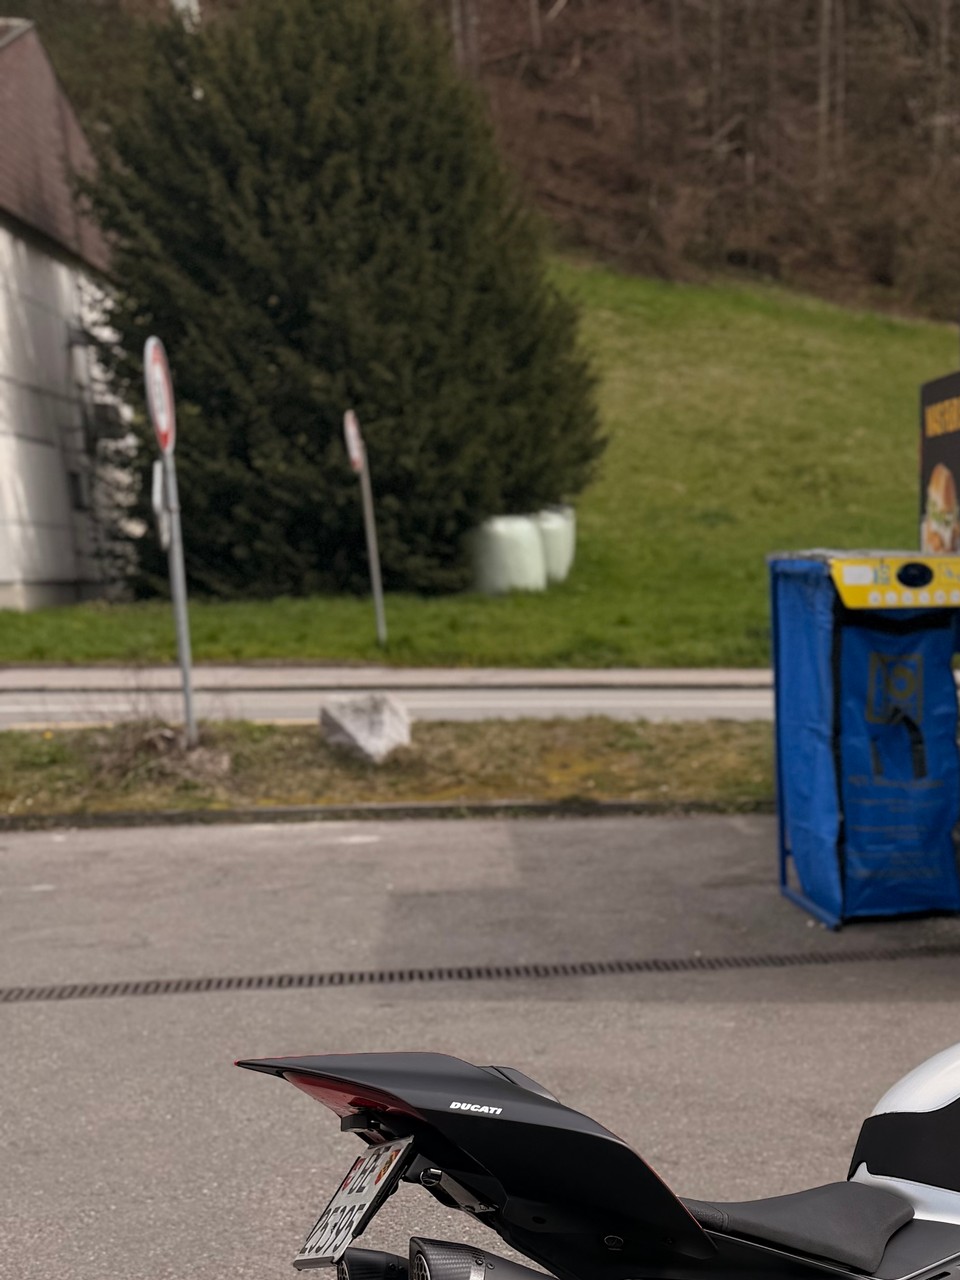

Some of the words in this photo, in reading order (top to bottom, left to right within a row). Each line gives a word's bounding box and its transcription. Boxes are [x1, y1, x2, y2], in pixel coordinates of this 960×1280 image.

[449, 1101, 503, 1115] DUCATI
[347, 1145, 394, 1195] BE
[299, 1203, 367, 1256] 25395
